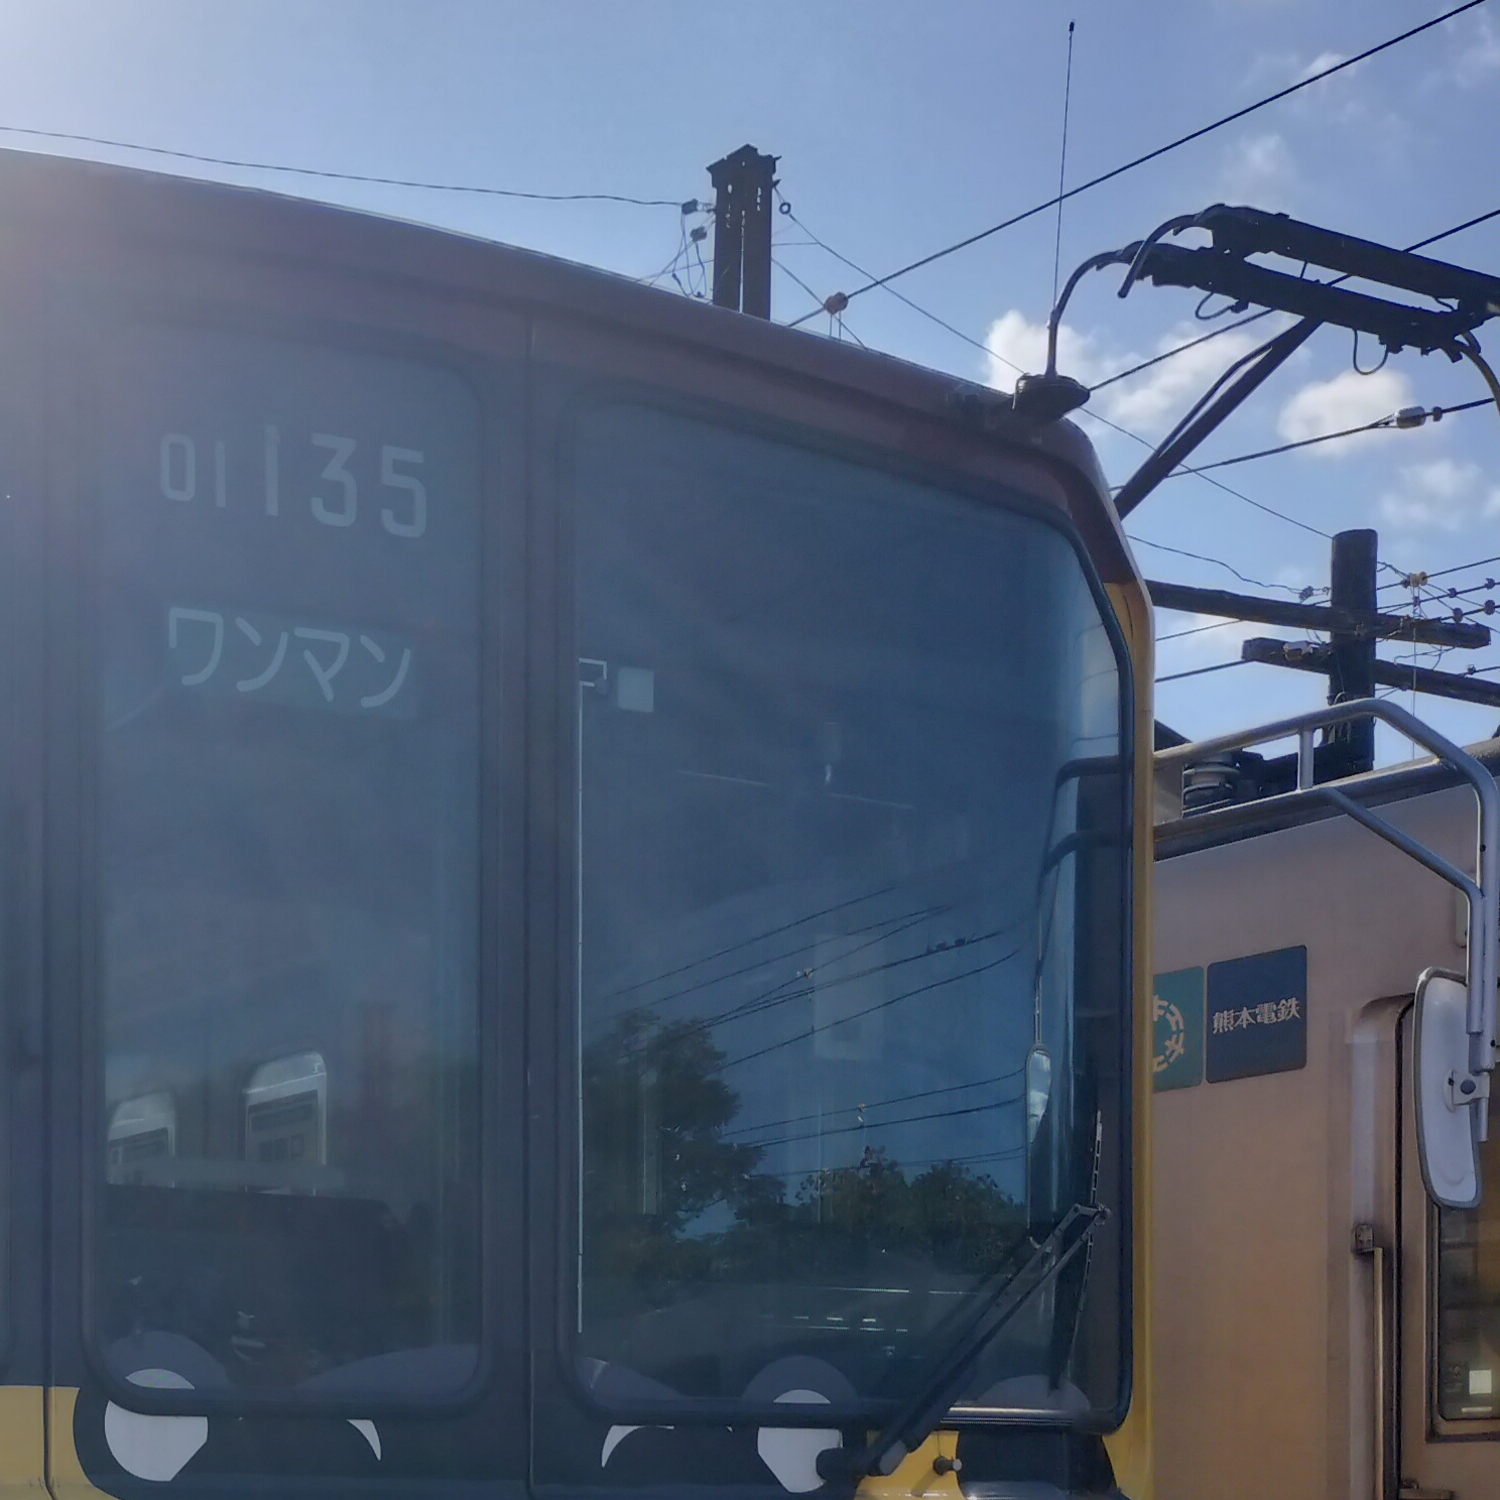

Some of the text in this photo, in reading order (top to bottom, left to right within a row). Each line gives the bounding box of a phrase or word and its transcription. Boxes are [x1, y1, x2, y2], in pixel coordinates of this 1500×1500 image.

[167, 606, 411, 709] ワンマン
[1212, 997, 1301, 1034] 熊本電鉄
